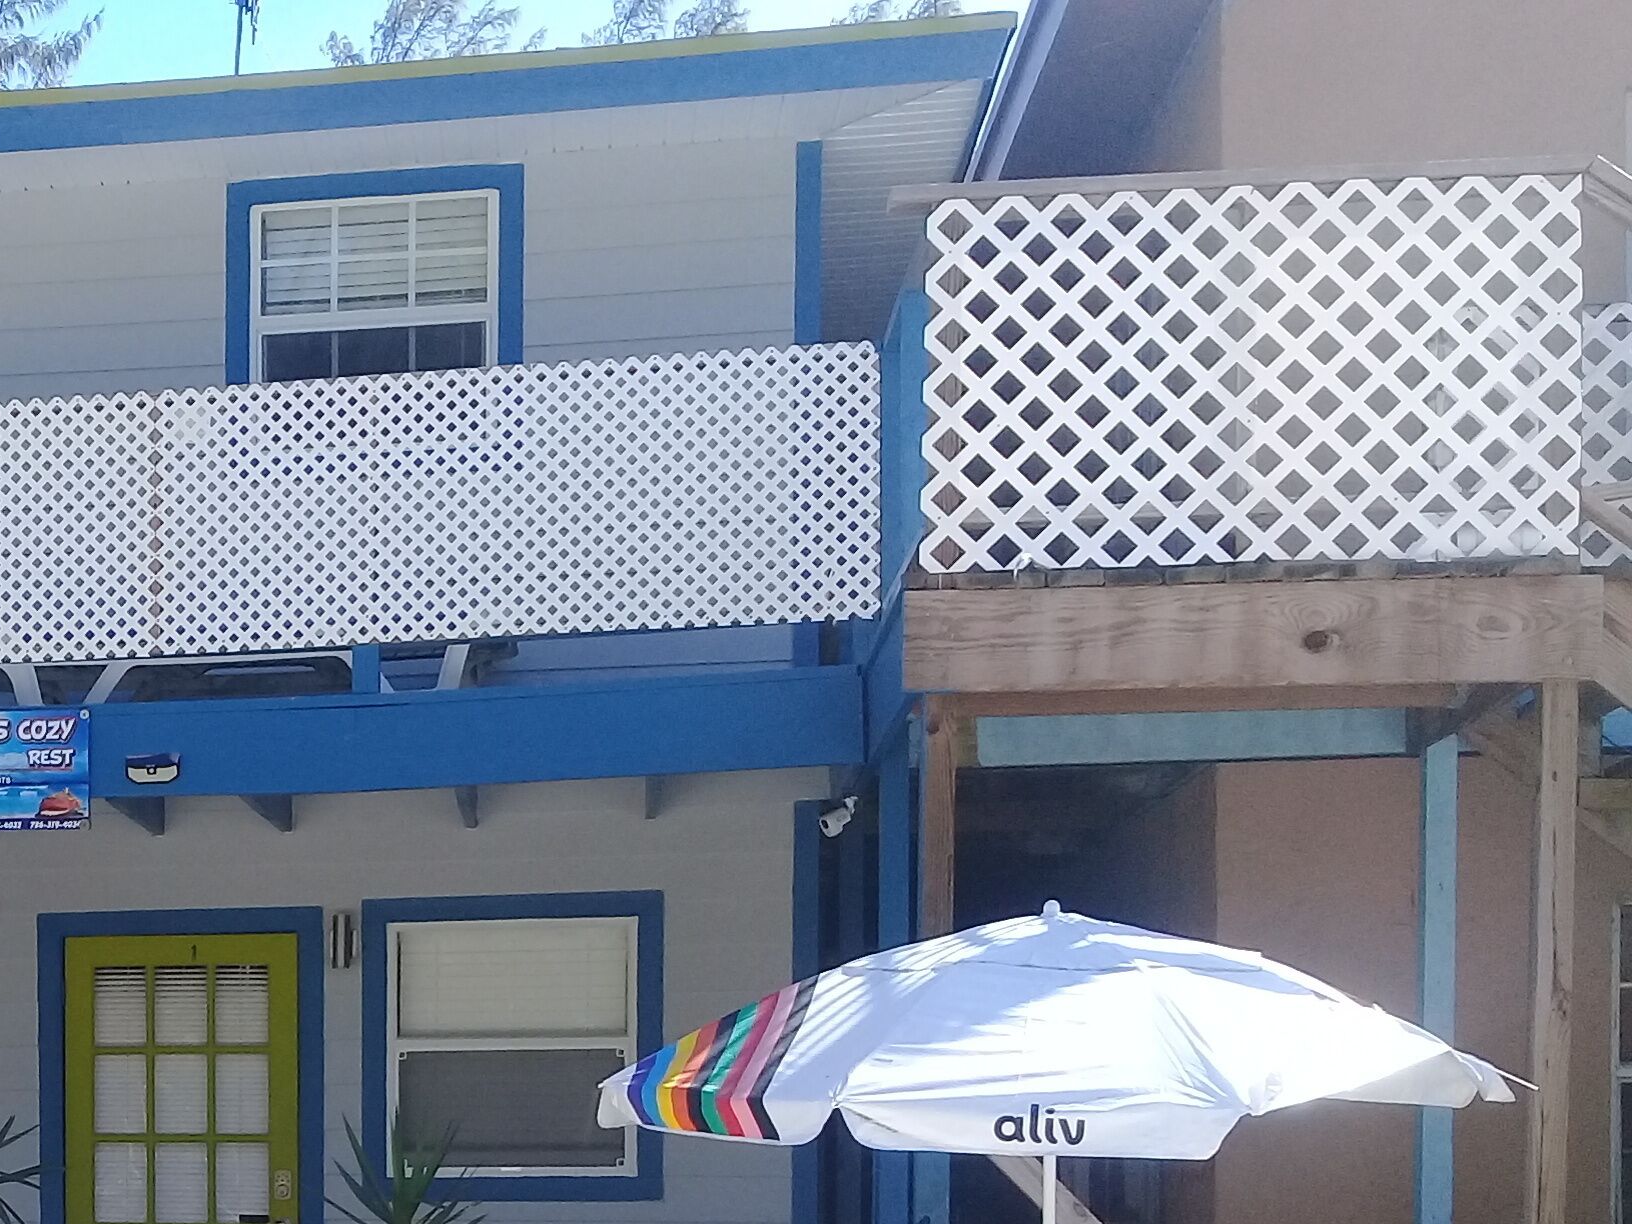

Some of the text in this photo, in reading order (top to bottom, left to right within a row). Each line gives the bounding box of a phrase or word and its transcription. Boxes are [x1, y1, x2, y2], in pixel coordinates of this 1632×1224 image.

[18, 717, 75, 742] COZY
[28, 749, 74, 766] REST
[191, 944, 197, 961] 1
[993, 1104, 1085, 1145] aliv
